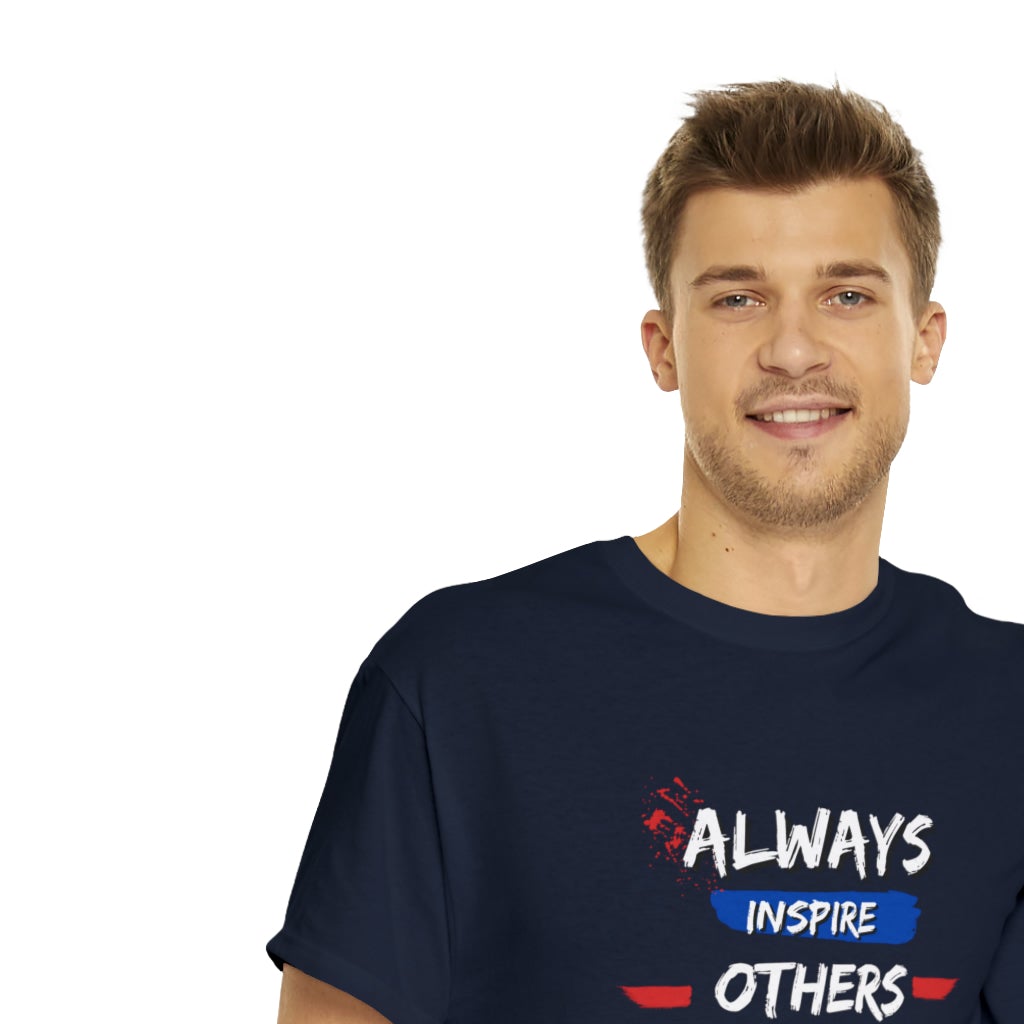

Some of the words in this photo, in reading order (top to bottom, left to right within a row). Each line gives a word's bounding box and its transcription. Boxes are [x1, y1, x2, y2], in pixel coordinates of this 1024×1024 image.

[682, 807, 934, 880] ALWAYS
[746, 899, 878, 939] INSPIRE
[714, 961, 909, 1022] OTHERS
